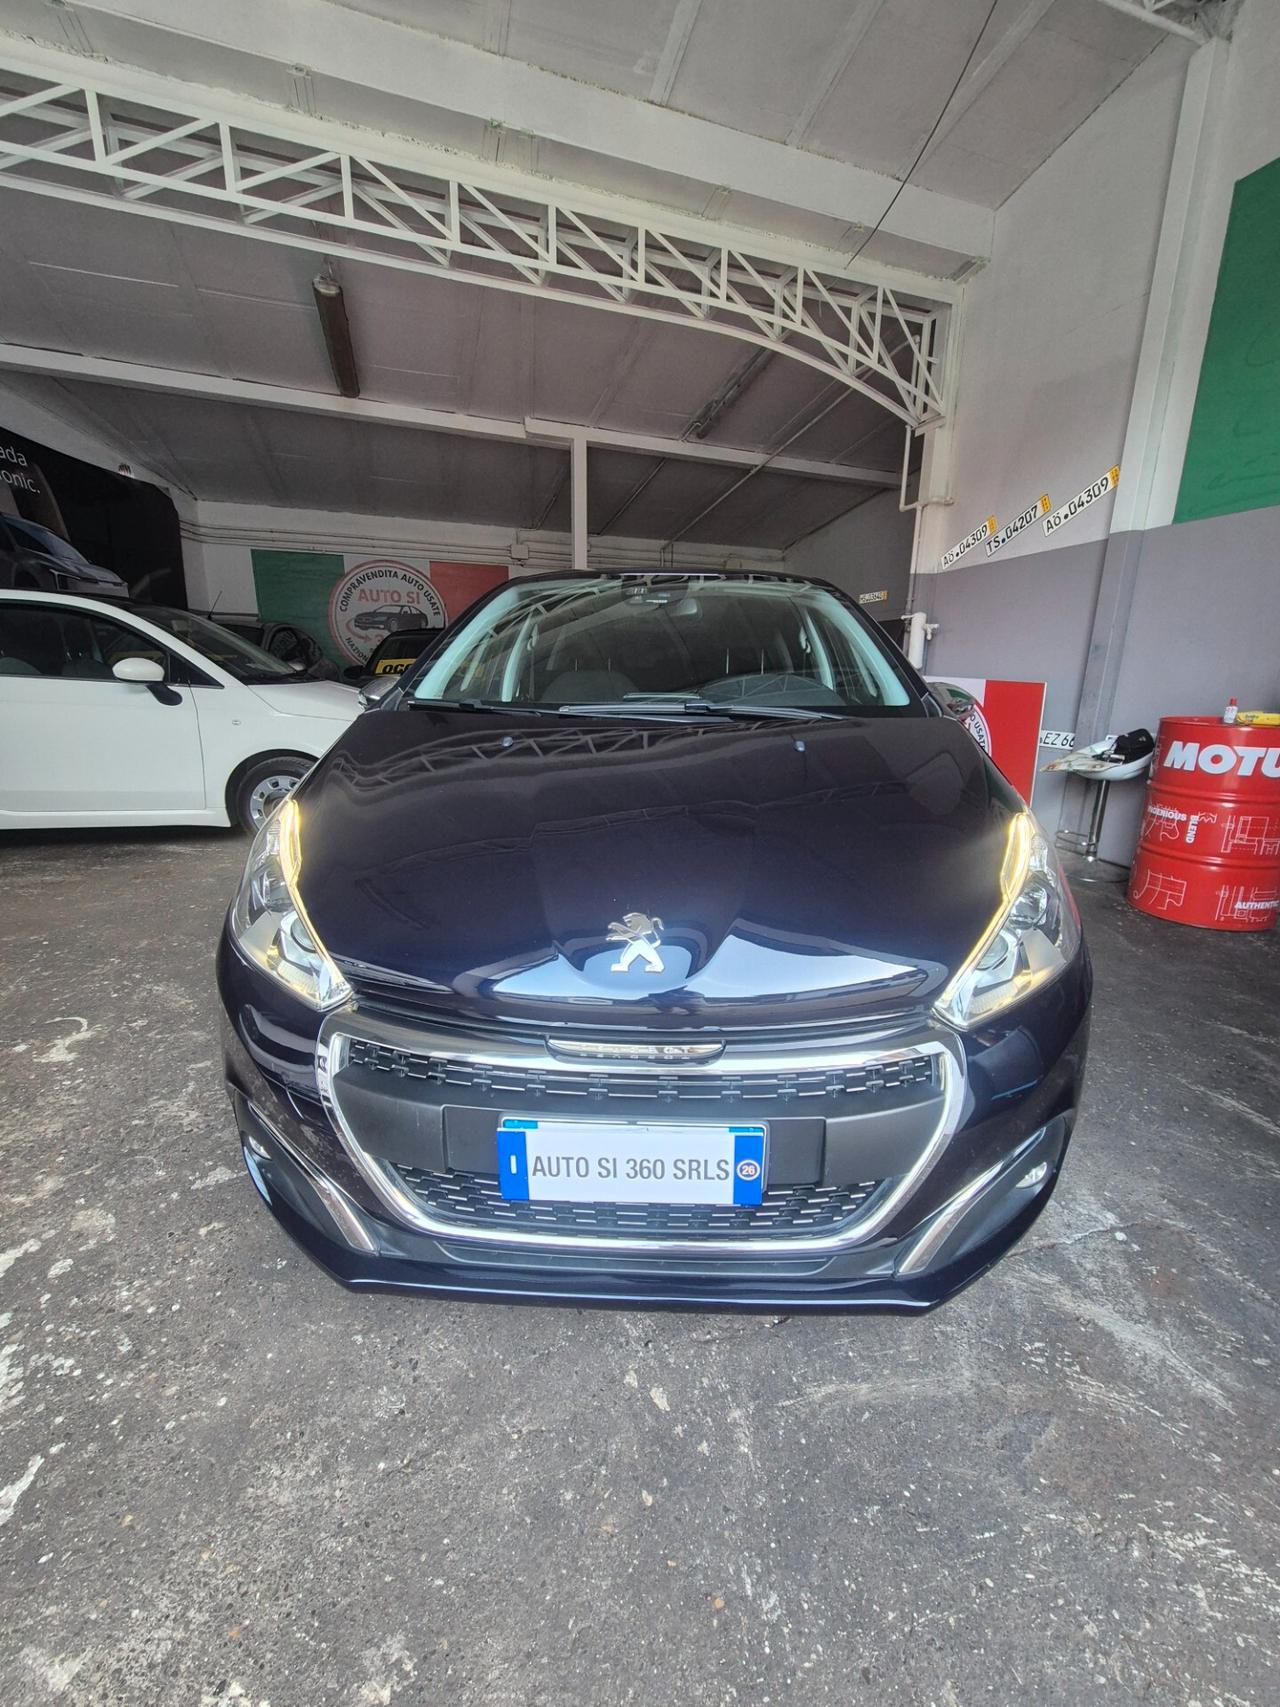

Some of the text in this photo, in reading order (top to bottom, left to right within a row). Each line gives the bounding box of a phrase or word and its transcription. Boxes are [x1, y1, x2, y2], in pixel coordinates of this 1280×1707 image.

[0, 470, 40, 494] onic.
[339, 569, 441, 616] COMPRAVENDITA AUTO USATE
[357, 588, 420, 605] AUTO SI
[532, 1155, 730, 1181] AUTO SI 360 SRLS
[741, 1164, 756, 1176] 26
